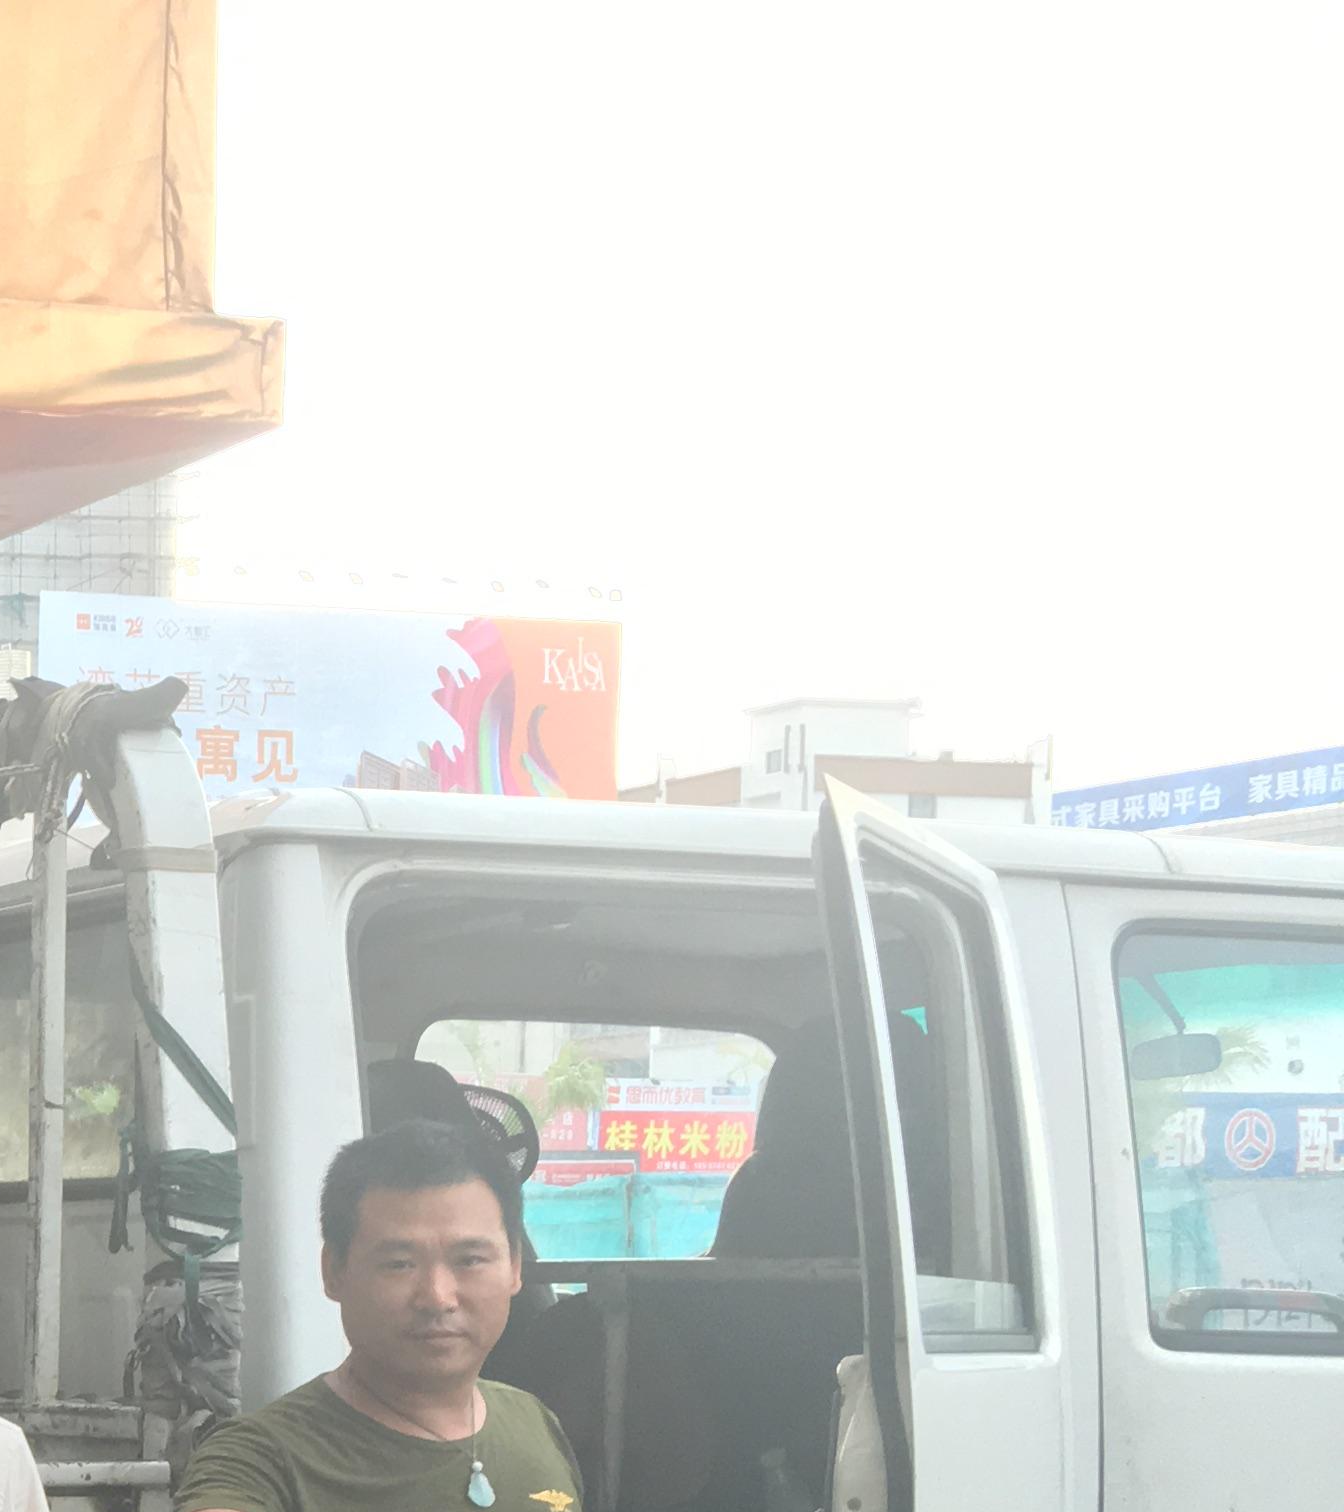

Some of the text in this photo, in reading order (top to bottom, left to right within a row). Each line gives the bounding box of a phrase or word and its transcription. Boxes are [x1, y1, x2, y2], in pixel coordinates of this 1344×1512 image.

[542, 636, 606, 693] KAISA
[604, 1119, 748, 1159] 桂林米粉
